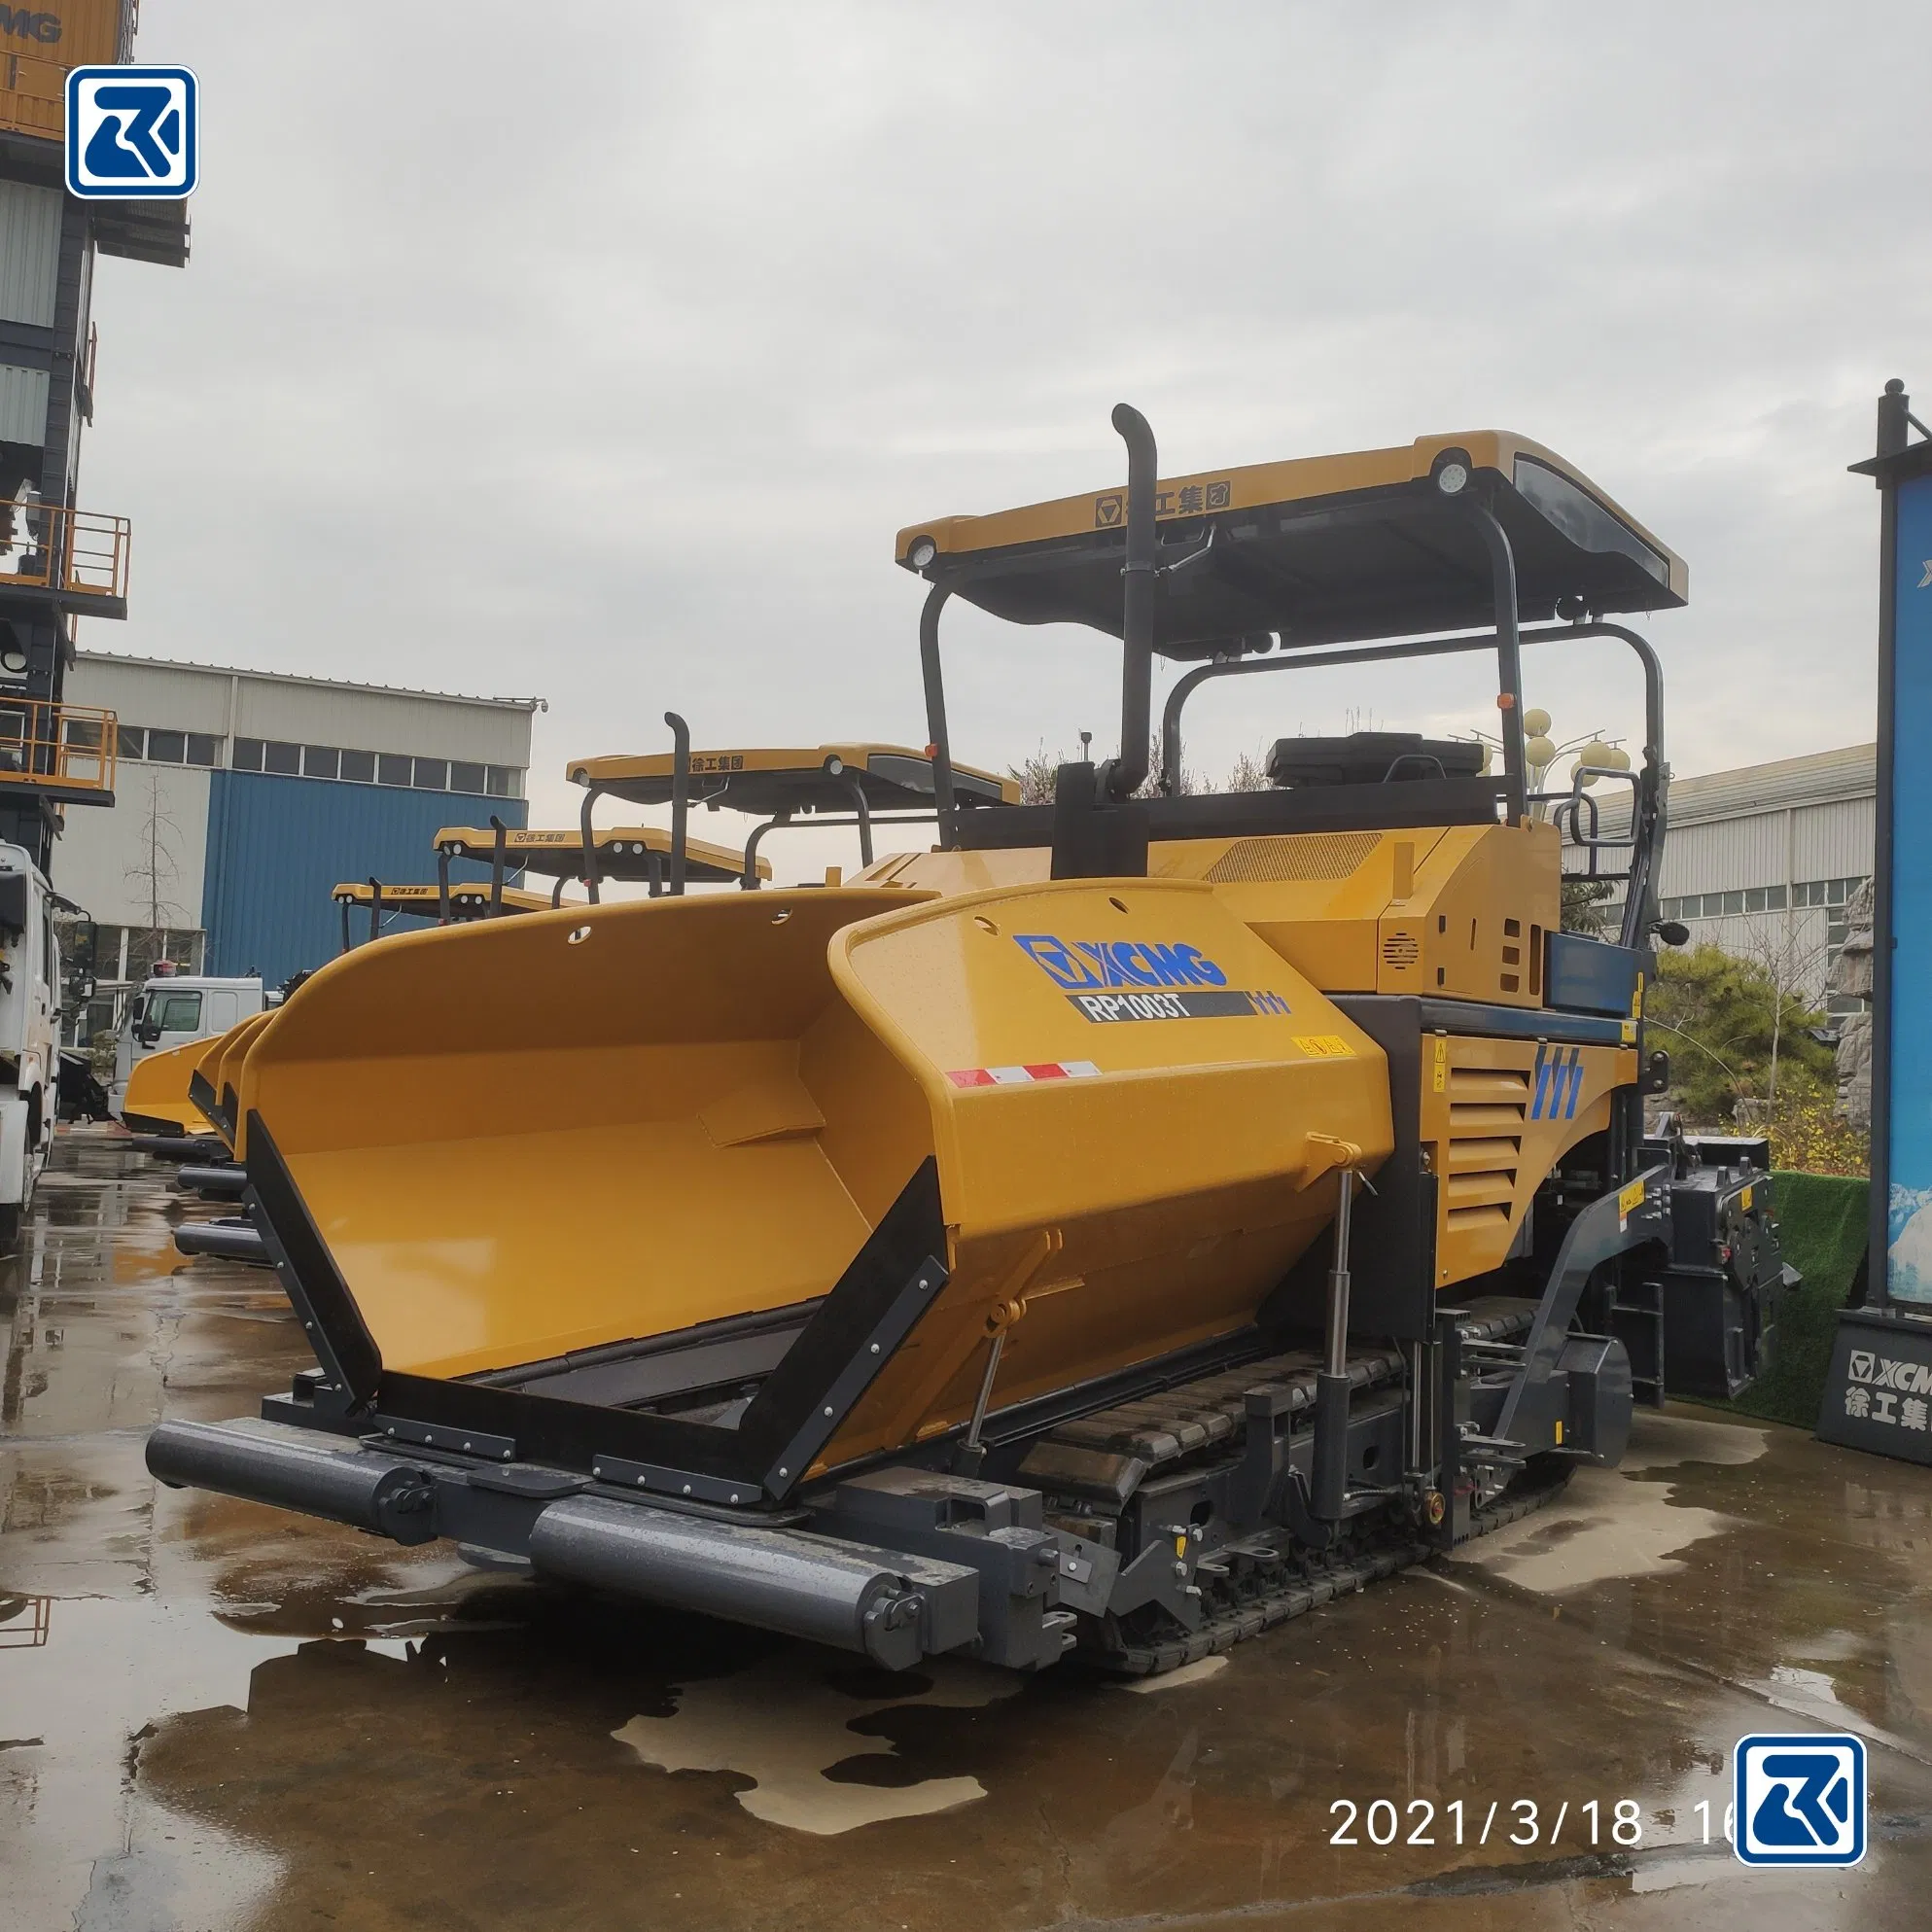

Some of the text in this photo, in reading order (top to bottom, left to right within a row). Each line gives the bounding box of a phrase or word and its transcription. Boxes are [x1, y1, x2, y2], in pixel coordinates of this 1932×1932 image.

[0, 3, 62, 44] MG
[1126, 480, 1232, 518] 工集团
[691, 755, 744, 773] 徐工集团
[1069, 941, 1228, 988] XCMG
[1077, 993, 1191, 1021] RP1003T
